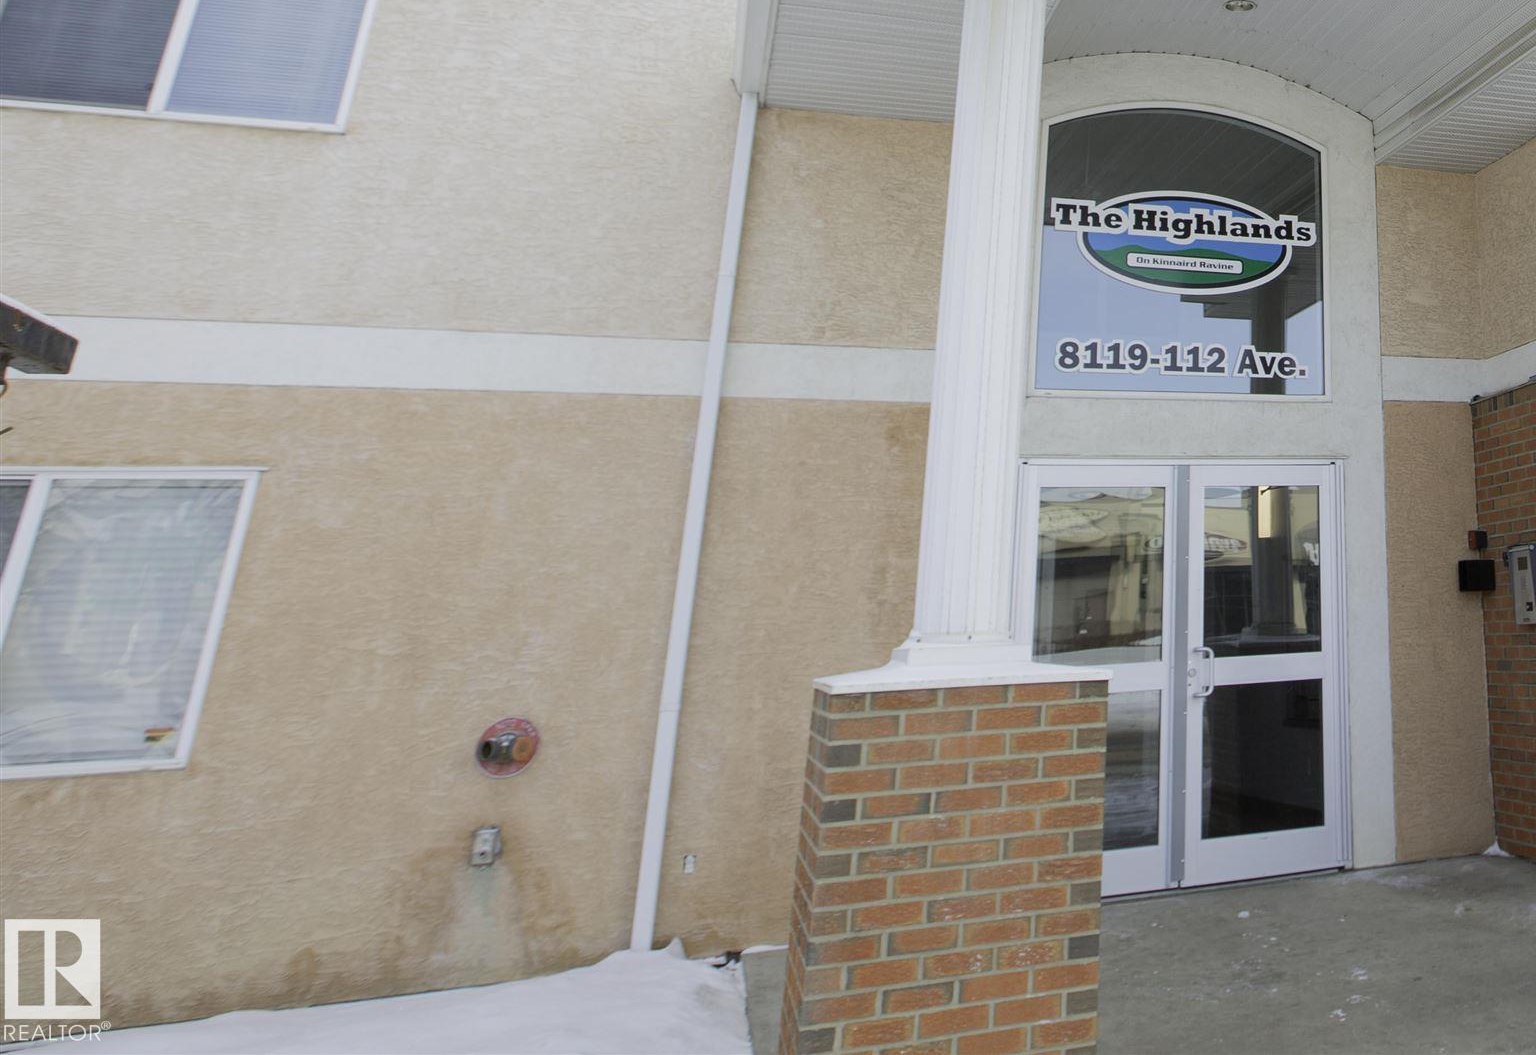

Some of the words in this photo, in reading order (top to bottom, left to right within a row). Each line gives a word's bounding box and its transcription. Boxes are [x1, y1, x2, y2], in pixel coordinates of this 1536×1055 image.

[1055, 202, 1123, 229] The
[1132, 208, 1312, 241] Highlands
[1136, 256, 1150, 265] On
[1152, 257, 1197, 268] Kinnaird
[1199, 261, 1235, 271] Ravine
[1057, 341, 1226, 374] 8119-112
[1237, 349, 1306, 377] Ave.
